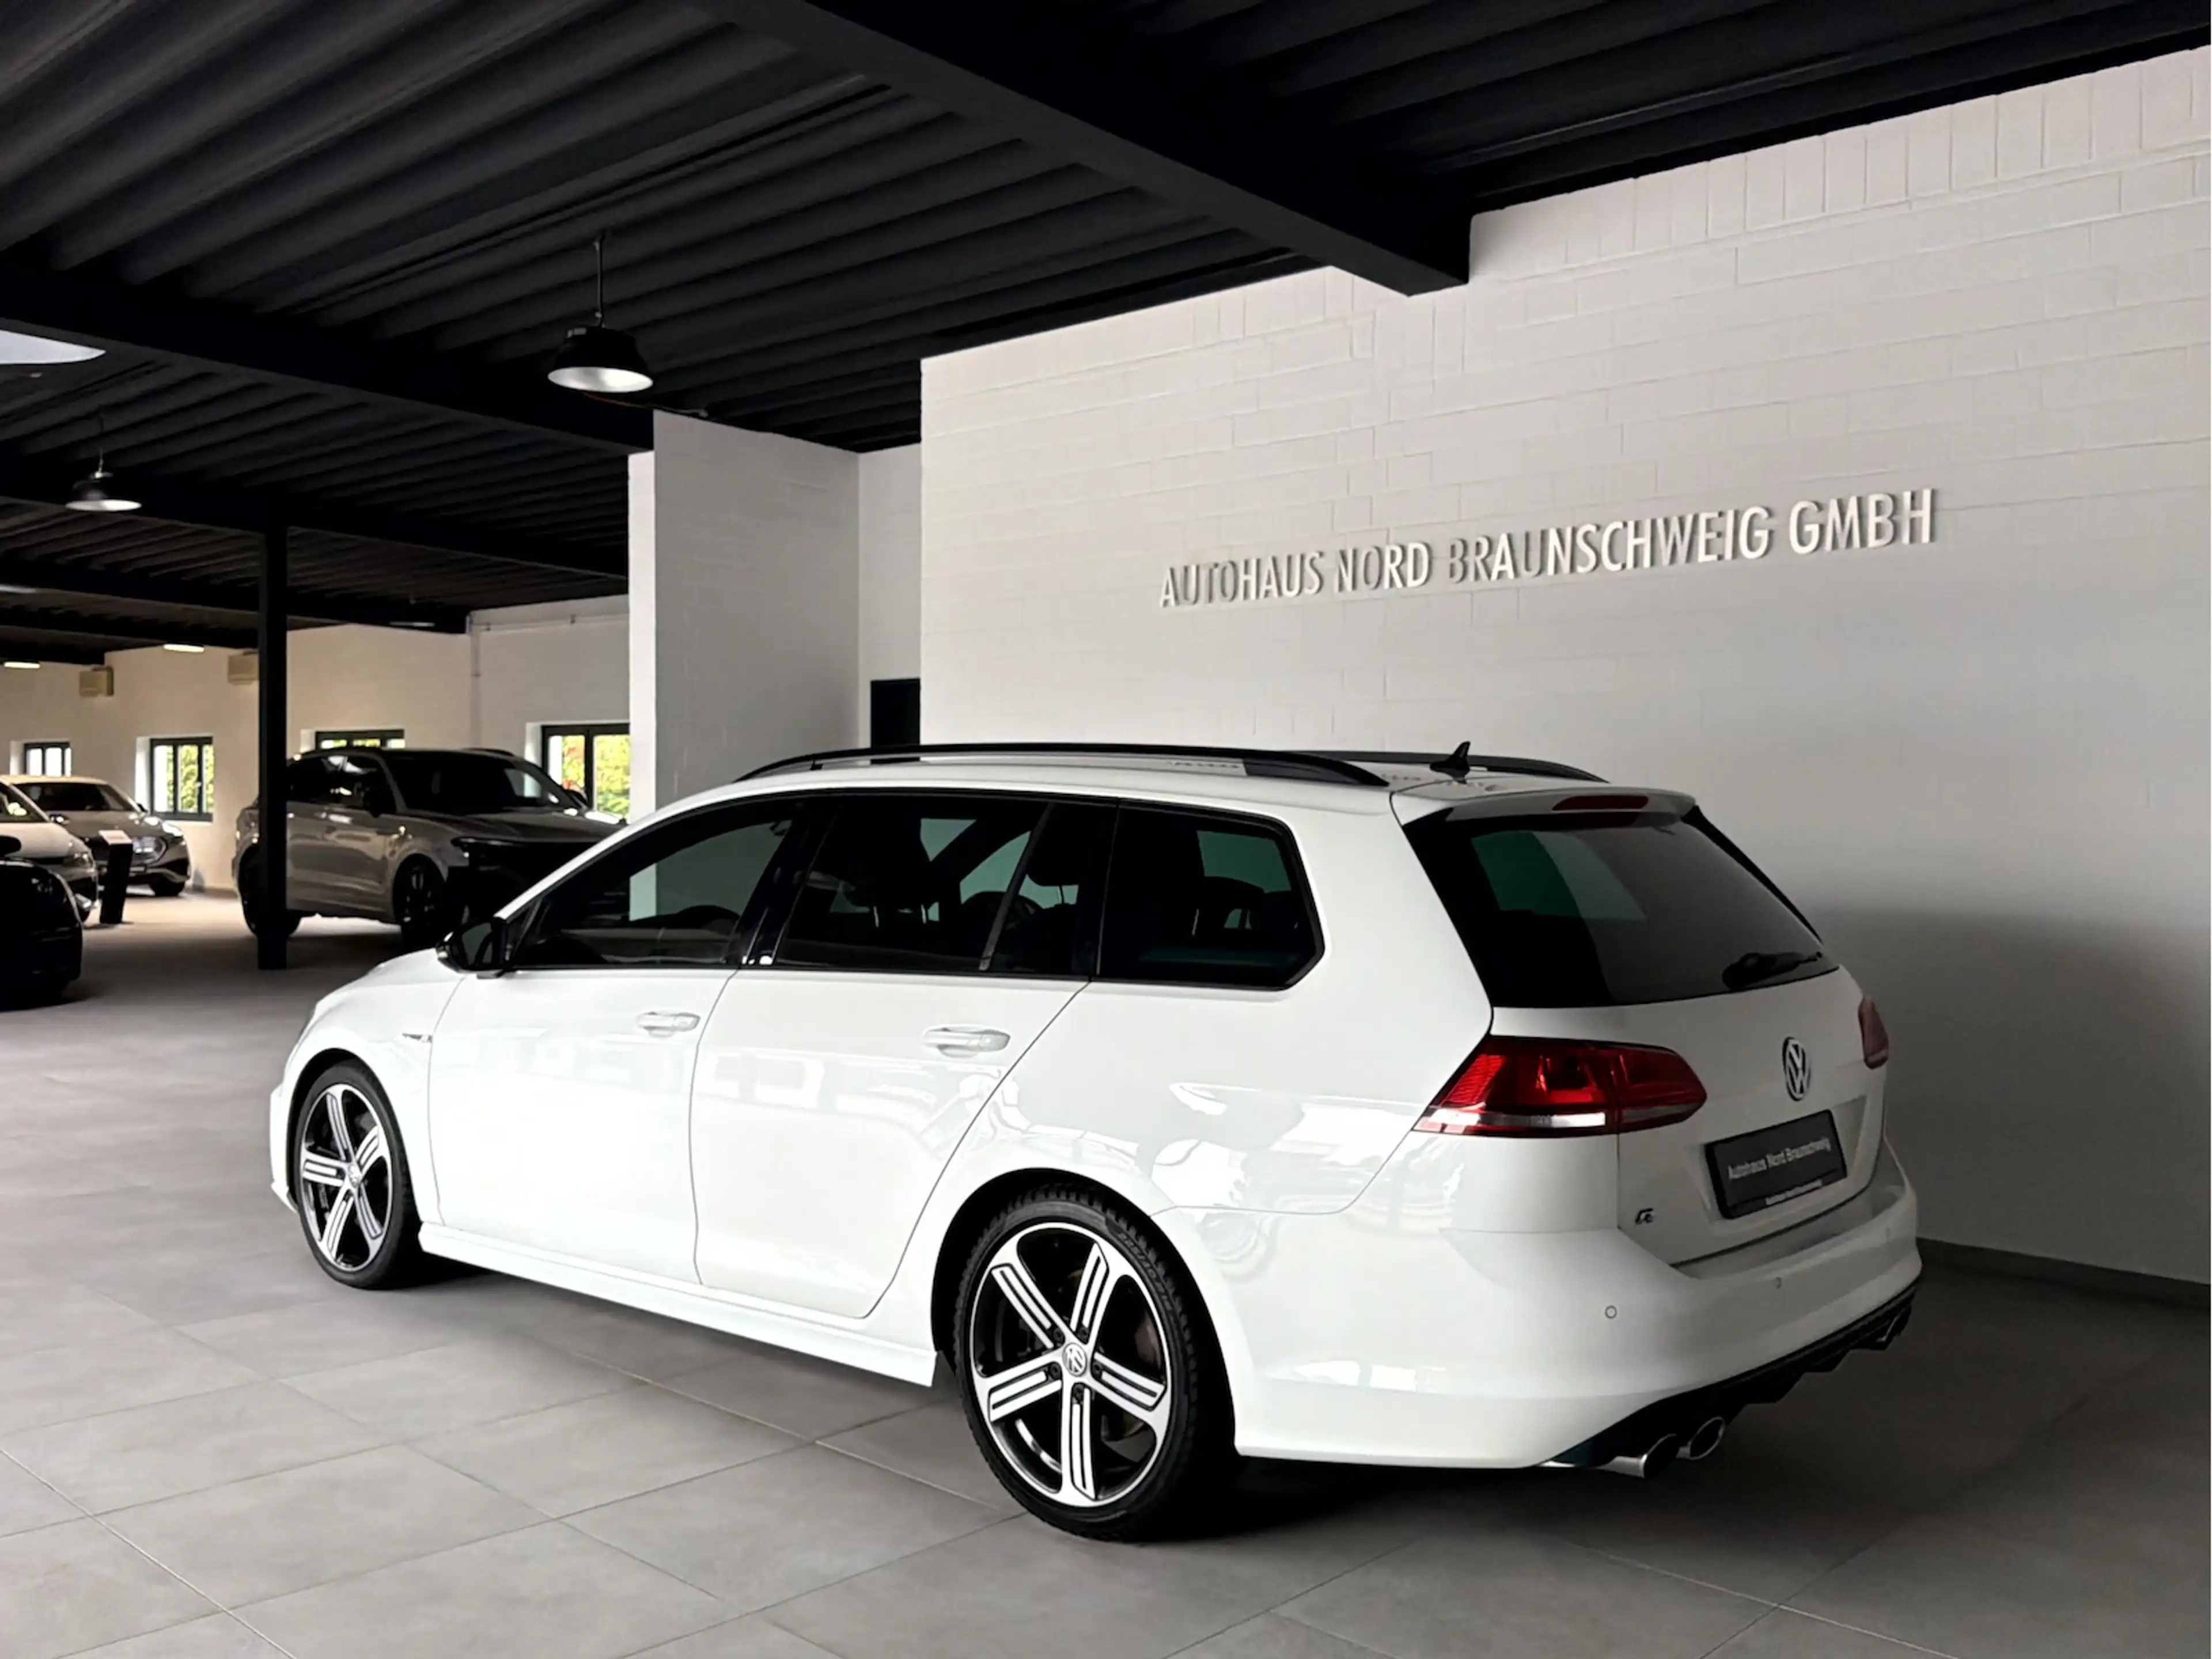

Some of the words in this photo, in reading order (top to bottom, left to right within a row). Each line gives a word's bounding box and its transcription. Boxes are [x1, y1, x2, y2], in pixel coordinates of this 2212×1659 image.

[1160, 550, 1325, 608] AUTOHAUS
[1334, 540, 1433, 594] NORD
[1448, 505, 1774, 584] BRAUNSCHWEIG
[1788, 488, 1938, 555] GMBH
